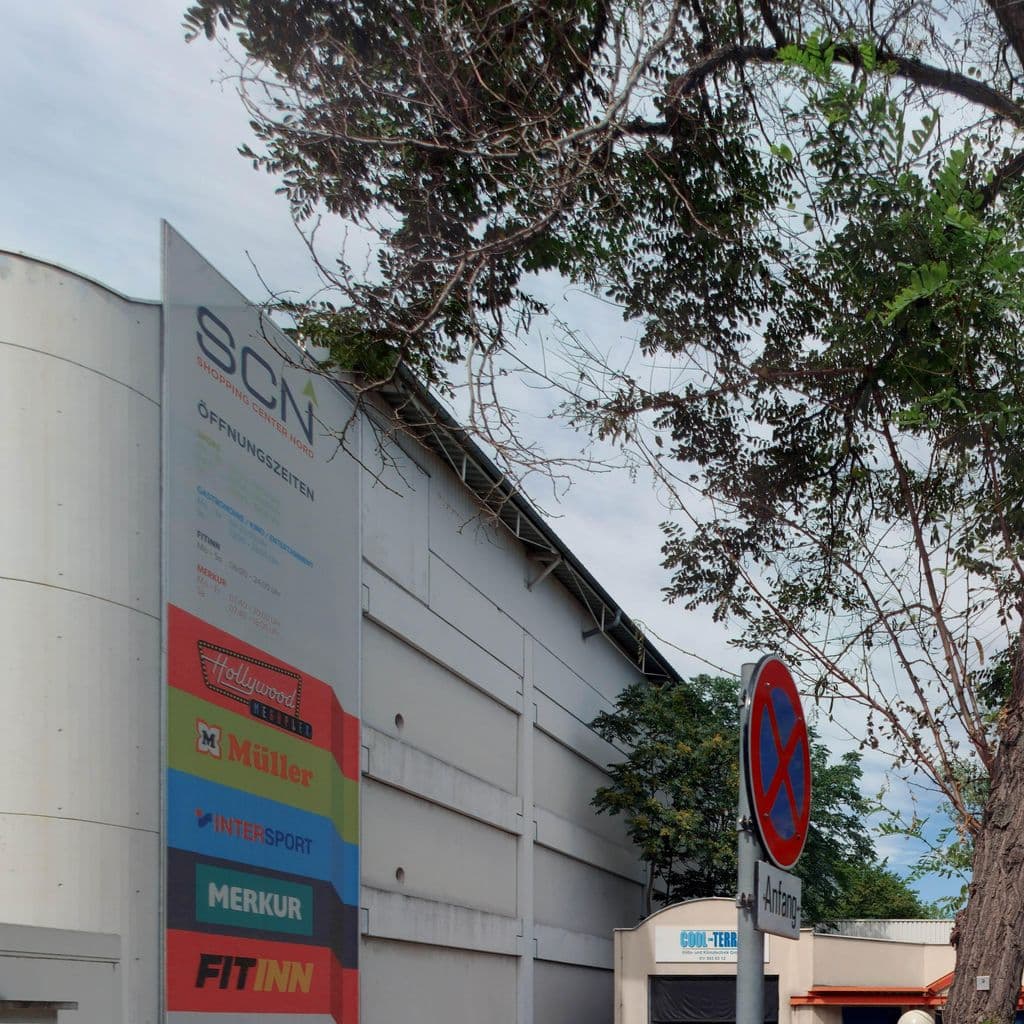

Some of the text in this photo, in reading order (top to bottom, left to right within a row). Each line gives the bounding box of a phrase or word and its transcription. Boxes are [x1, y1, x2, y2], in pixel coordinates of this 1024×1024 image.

[196, 306, 314, 446] SCN
[197, 356, 250, 406] SHOPPING
[251, 402, 288, 439] CENTER
[197, 399, 315, 502] ÖFFNUNGSZEITEN
[201, 652, 296, 709] Hollywood
[227, 732, 314, 789] Müller
[213, 814, 313, 855] INTERSPORT
[208, 881, 303, 921] MERKUR
[764, 874, 797, 930] Anfang
[680, 931, 738, 948] COOL-TERR
